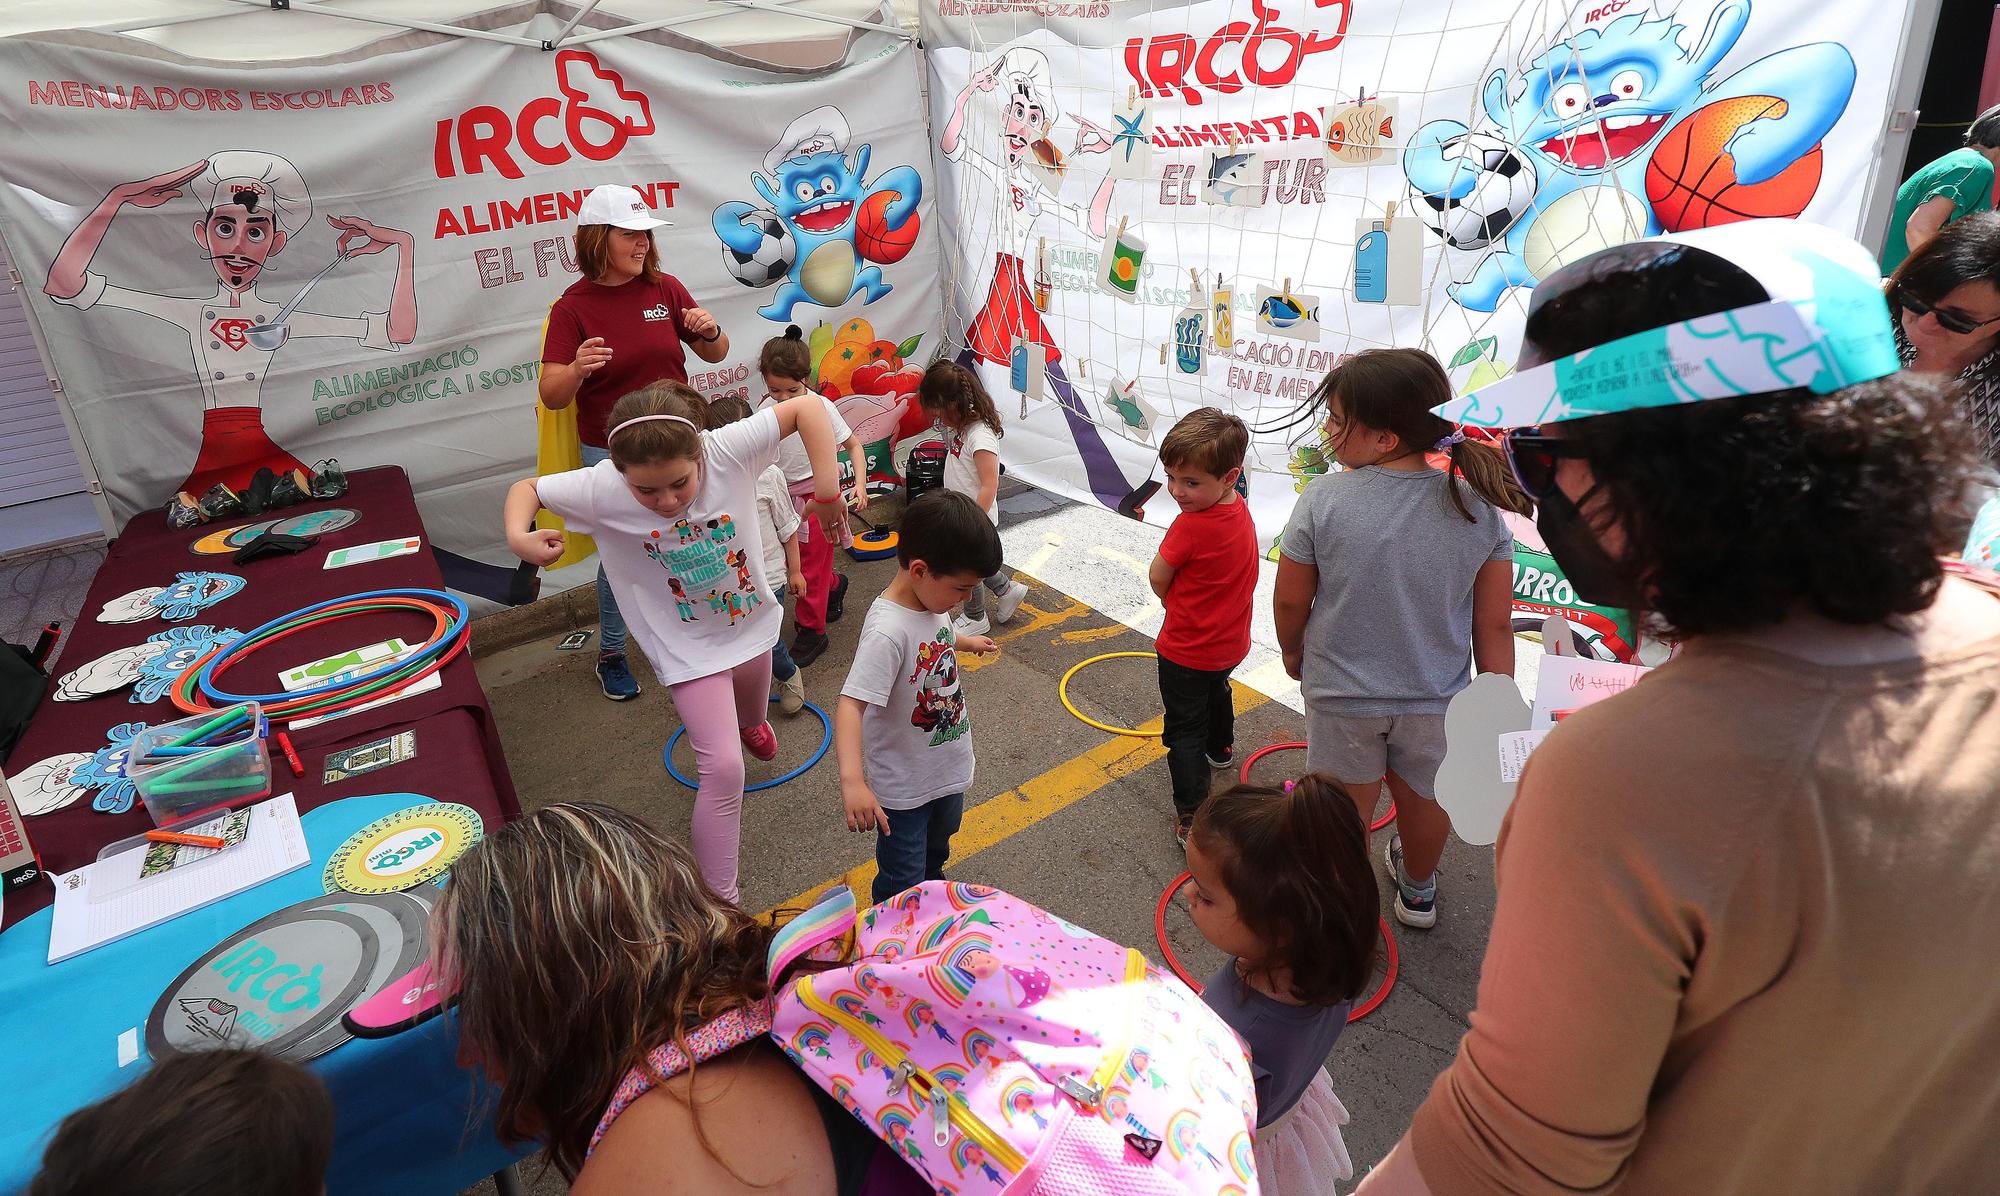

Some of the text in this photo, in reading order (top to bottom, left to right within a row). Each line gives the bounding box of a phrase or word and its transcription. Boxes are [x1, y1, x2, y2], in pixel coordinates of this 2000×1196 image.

[28, 80, 395, 112] MENJADORS ESCOLARS
[1159, 158, 1329, 206] EL TUR
[434, 182, 680, 240] ALIMENNT
[474, 246, 524, 289] EL
[312, 345, 479, 401] ALIMENTACIÓ
[1228, 366, 1253, 391] EN
[1254, 371, 1274, 395] EL
[314, 377, 462, 427] ECOLÒGICA
[466, 373, 475, 393] I
[236, 1009, 285, 1040] mini
